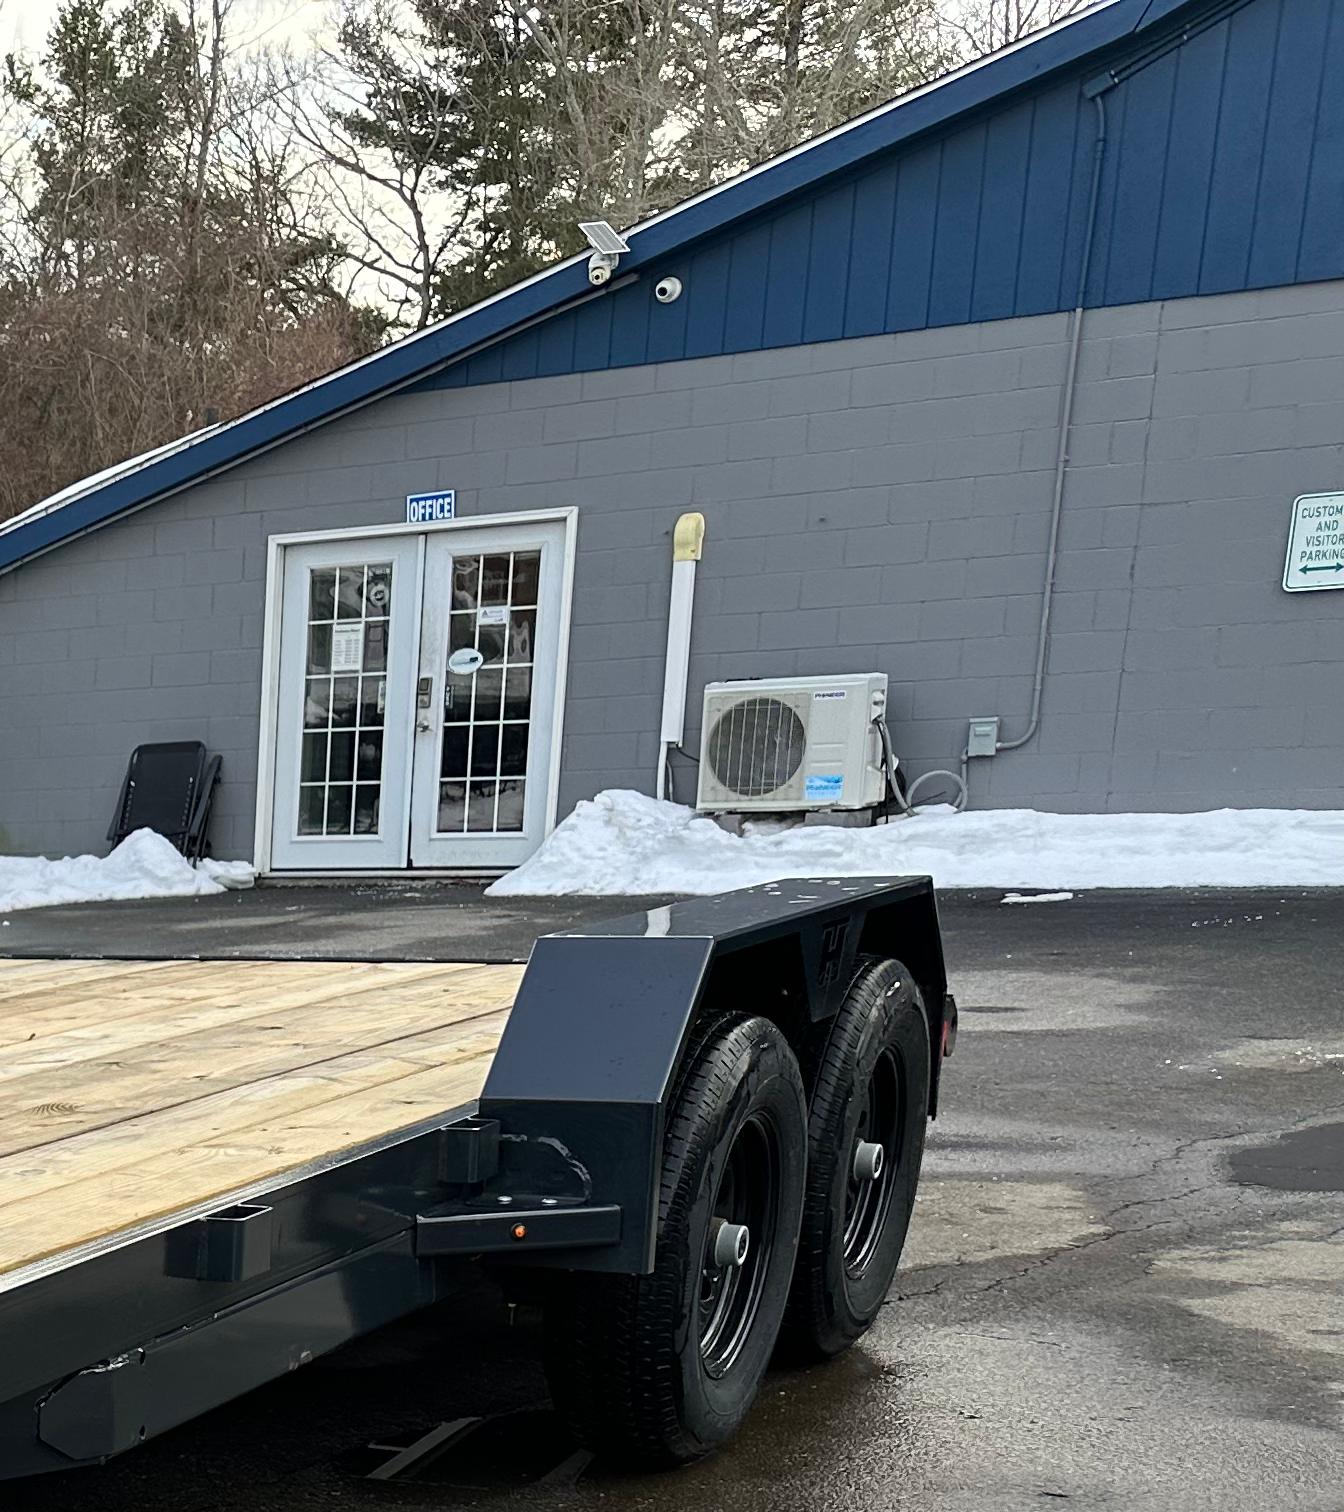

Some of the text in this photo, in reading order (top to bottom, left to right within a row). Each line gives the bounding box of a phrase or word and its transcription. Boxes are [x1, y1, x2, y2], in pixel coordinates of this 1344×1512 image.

[409, 497, 452, 522] OFFICE
[1302, 504, 1344, 518] CUSTOM
[1316, 520, 1339, 532] AND
[1305, 534, 1344, 547] VISITOR
[1300, 549, 1344, 562] PARKING
